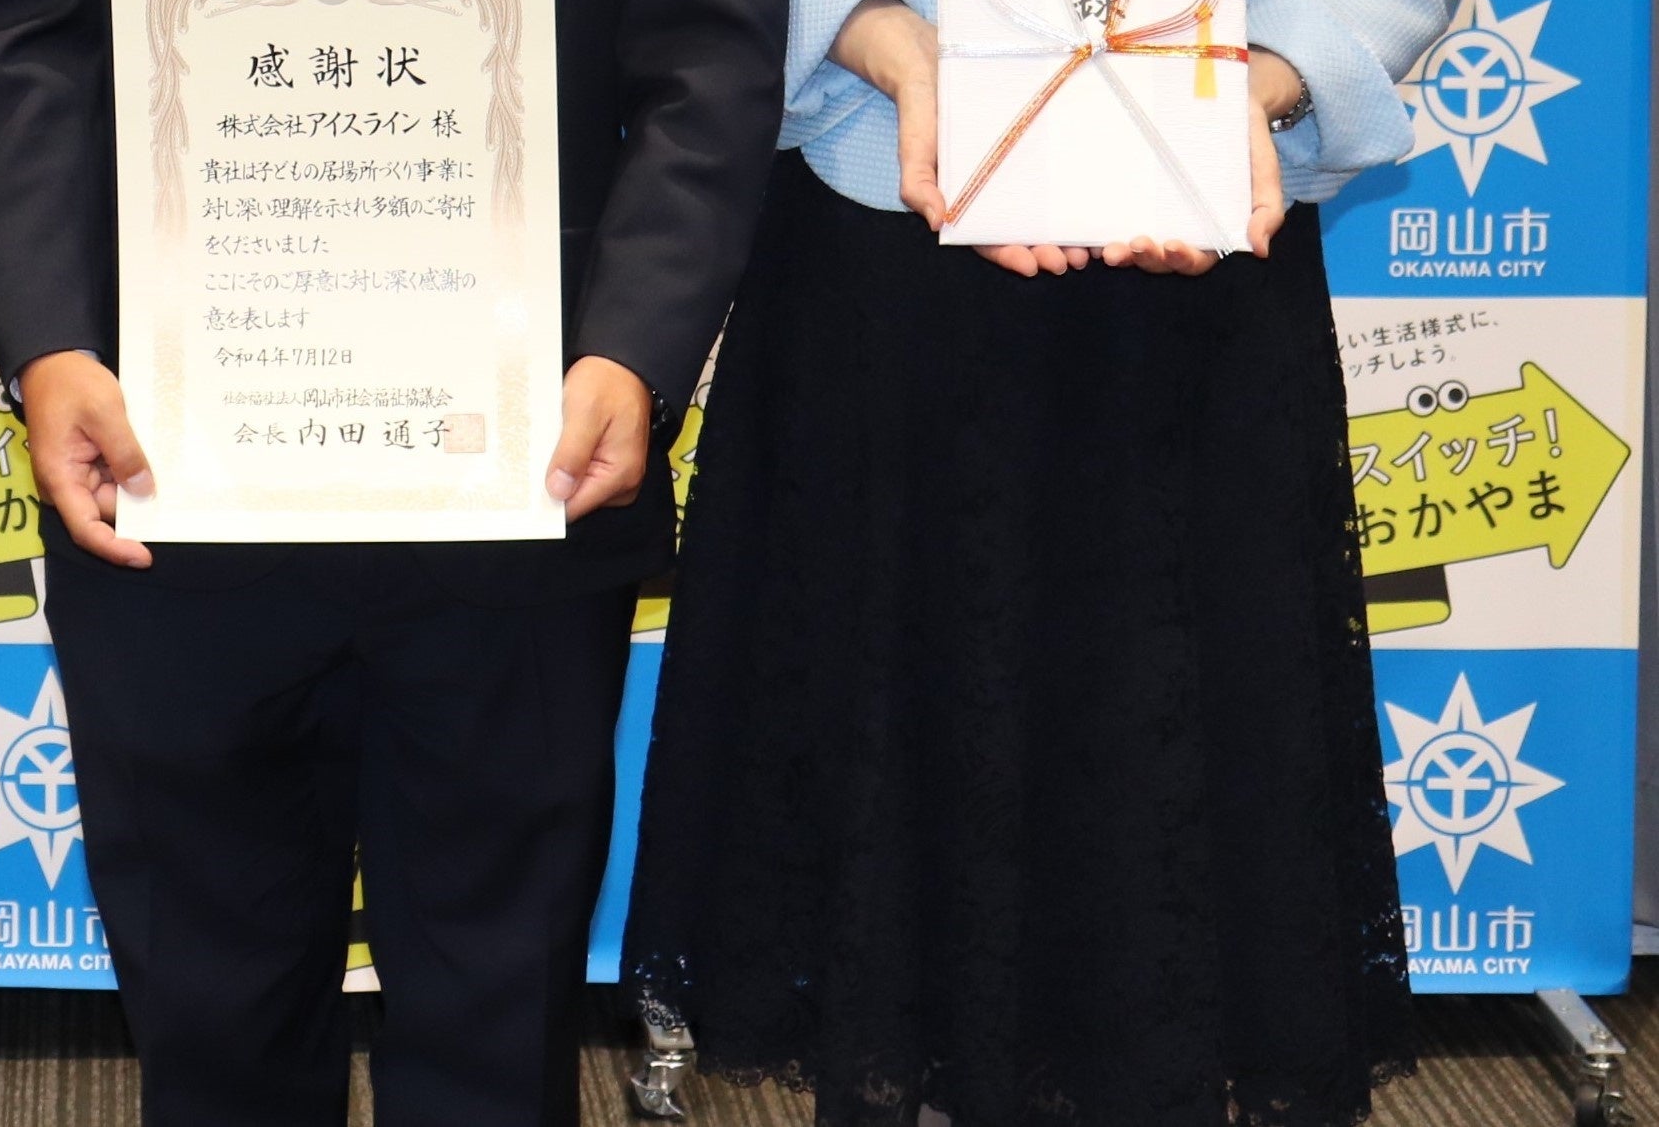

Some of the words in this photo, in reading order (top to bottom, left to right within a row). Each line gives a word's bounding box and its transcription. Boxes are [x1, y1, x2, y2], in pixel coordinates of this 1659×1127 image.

[246, 42, 427, 90] 感謝状
[199, 158, 475, 184] 貴社は子どもの居場所づくり事業に
[201, 195, 476, 221] 対し深い理解を示され多額のご寄付
[1389, 206, 1550, 256] 岡山市
[204, 234, 330, 257] をくださいました
[1388, 261, 1491, 277] OKAYAMA
[1497, 260, 1547, 278] CITY
[202, 305, 311, 332] 意を表します
[1339, 311, 1499, 351] い生活様式に、
[1357, 470, 1566, 549] おかやま
[1483, 958, 1531, 975] CITY
